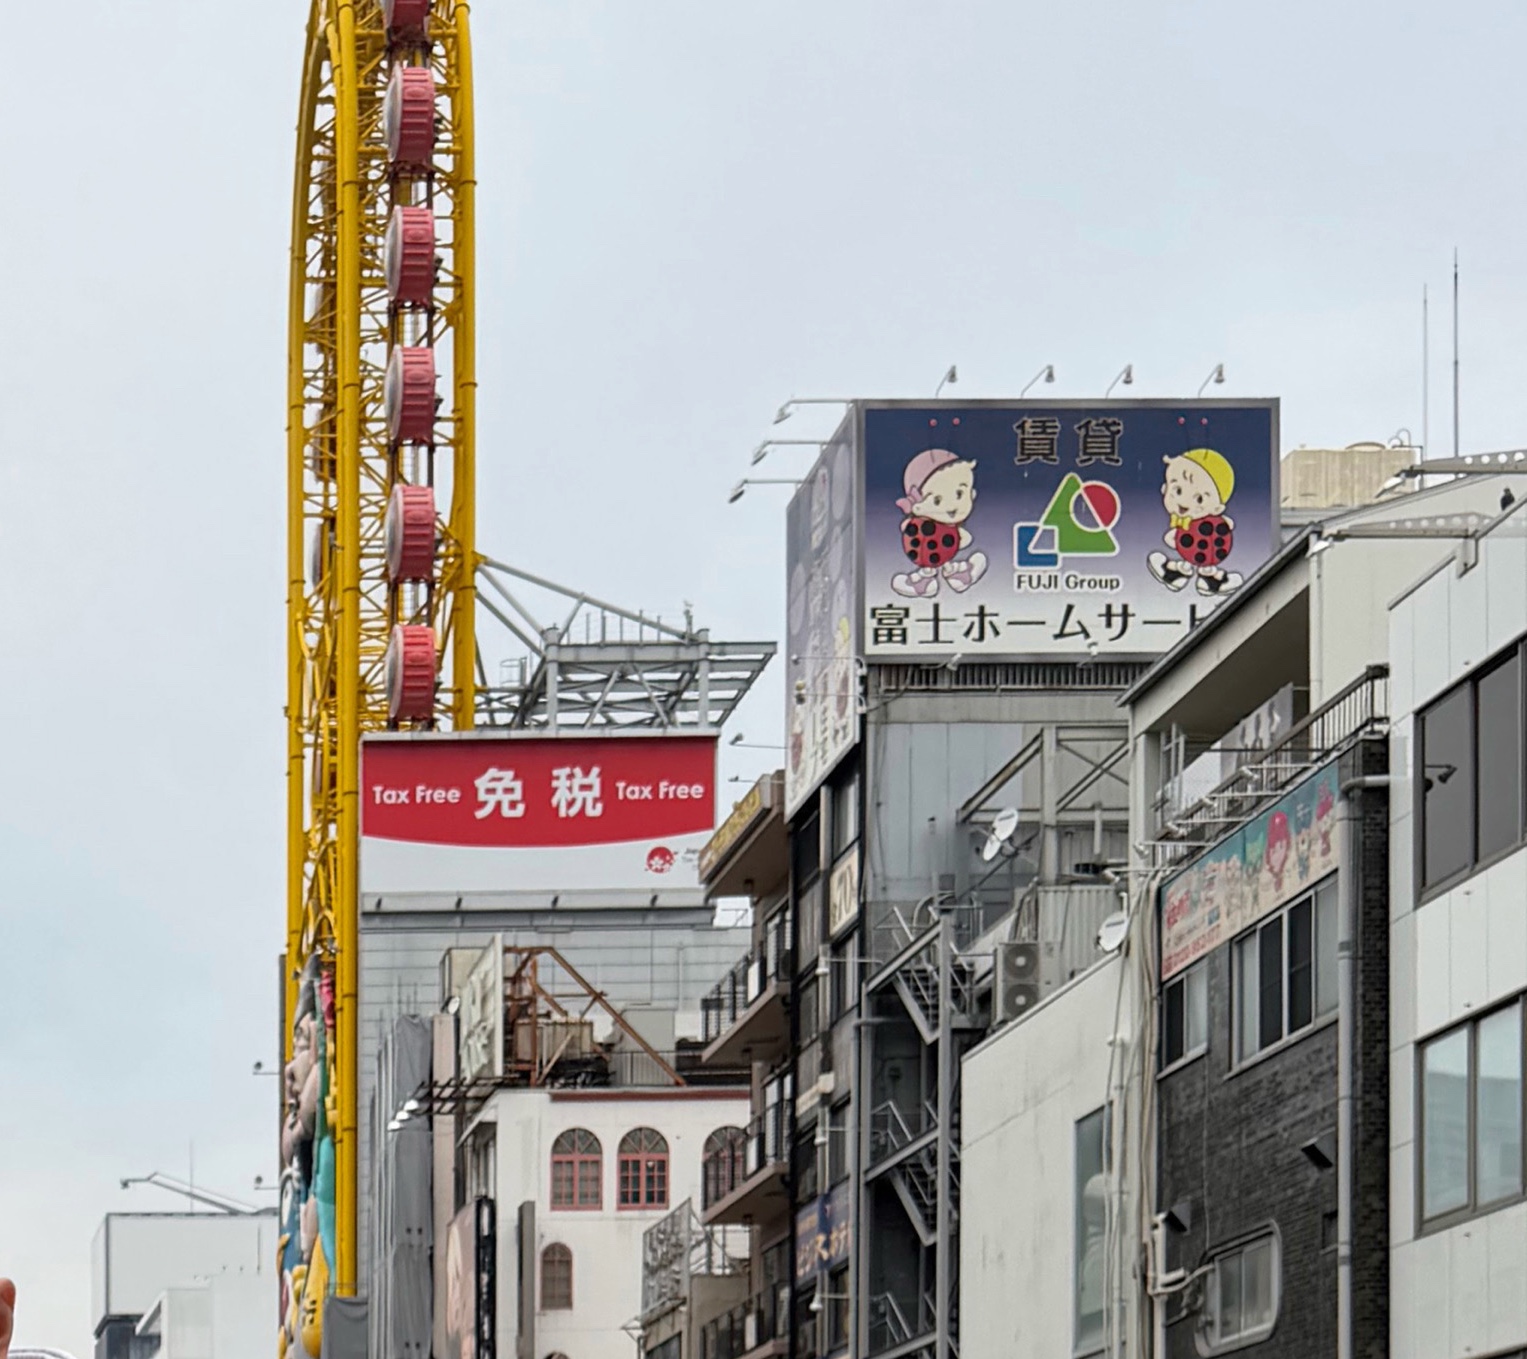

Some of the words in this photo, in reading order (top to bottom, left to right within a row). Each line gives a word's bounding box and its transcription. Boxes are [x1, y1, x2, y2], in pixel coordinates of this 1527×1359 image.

[1013, 417, 1123, 466] 賃貸
[1016, 574, 1059, 590] FUJI
[1064, 573, 1121, 591] Group
[373, 785, 409, 804] Tax
[415, 785, 462, 804] Free
[473, 765, 604, 819] 免税
[616, 780, 653, 800] Tax
[659, 780, 705, 799] Free
